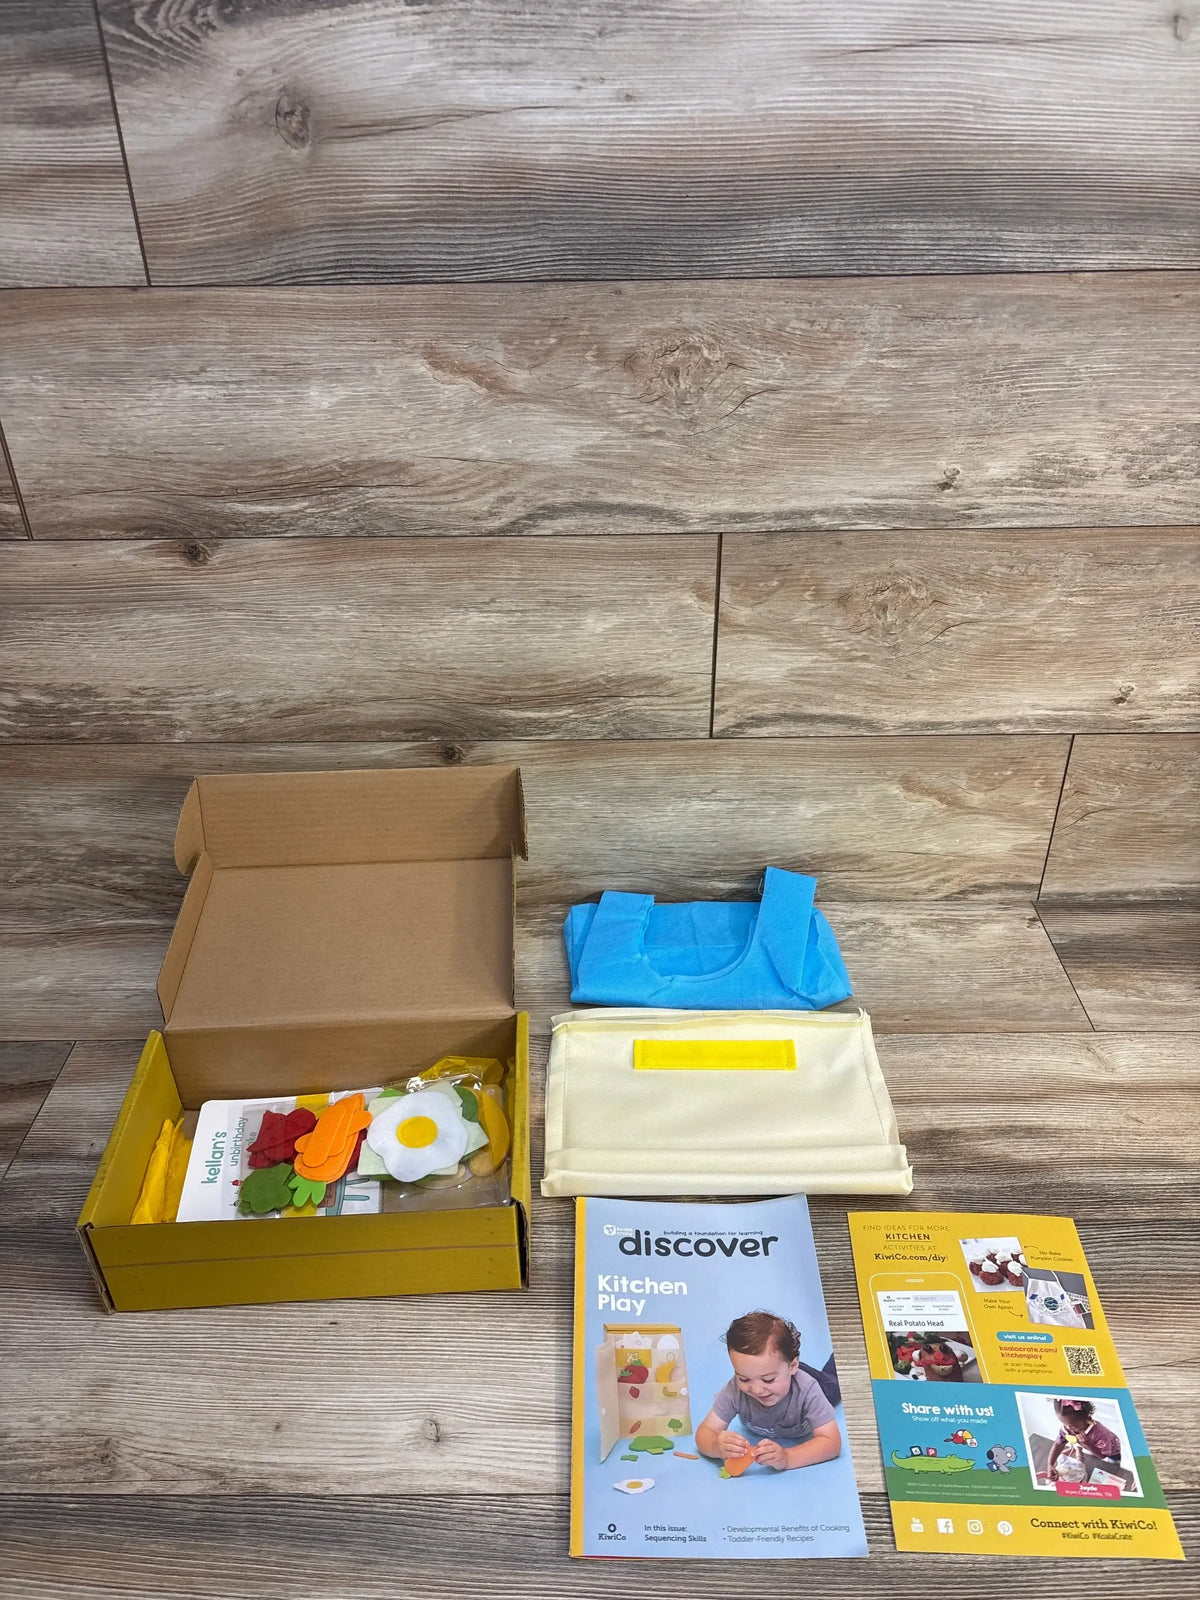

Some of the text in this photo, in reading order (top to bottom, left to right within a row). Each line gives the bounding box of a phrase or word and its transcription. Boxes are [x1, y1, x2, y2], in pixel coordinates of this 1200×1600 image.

[230, 1117, 248, 1166] unbirthday
[201, 1131, 227, 1184] kellan's
[885, 1233, 931, 1241] KITCHEN
[618, 1229, 779, 1257] discover
[598, 1275, 688, 1295] Kitchen
[598, 1294, 646, 1316] Play
[1001, 1353, 1042, 1361] kitchenplay
[901, 1402, 995, 1417] Share with us!
[652, 1524, 667, 1532] this
[667, 1524, 688, 1532] issue:
[1030, 1517, 1158, 1530] Connect with KiwiCo!
[726, 1525, 779, 1534] Developmental
[819, 1524, 850, 1533] Cooking
[598, 1533, 627, 1541] KiwiCo
[644, 1534, 707, 1543] Sequencing Skills
[728, 1535, 814, 1543] Toddler-Friendly Recipes
[1061, 1532, 1133, 1540] #KiwiCo #KoalaCrate
